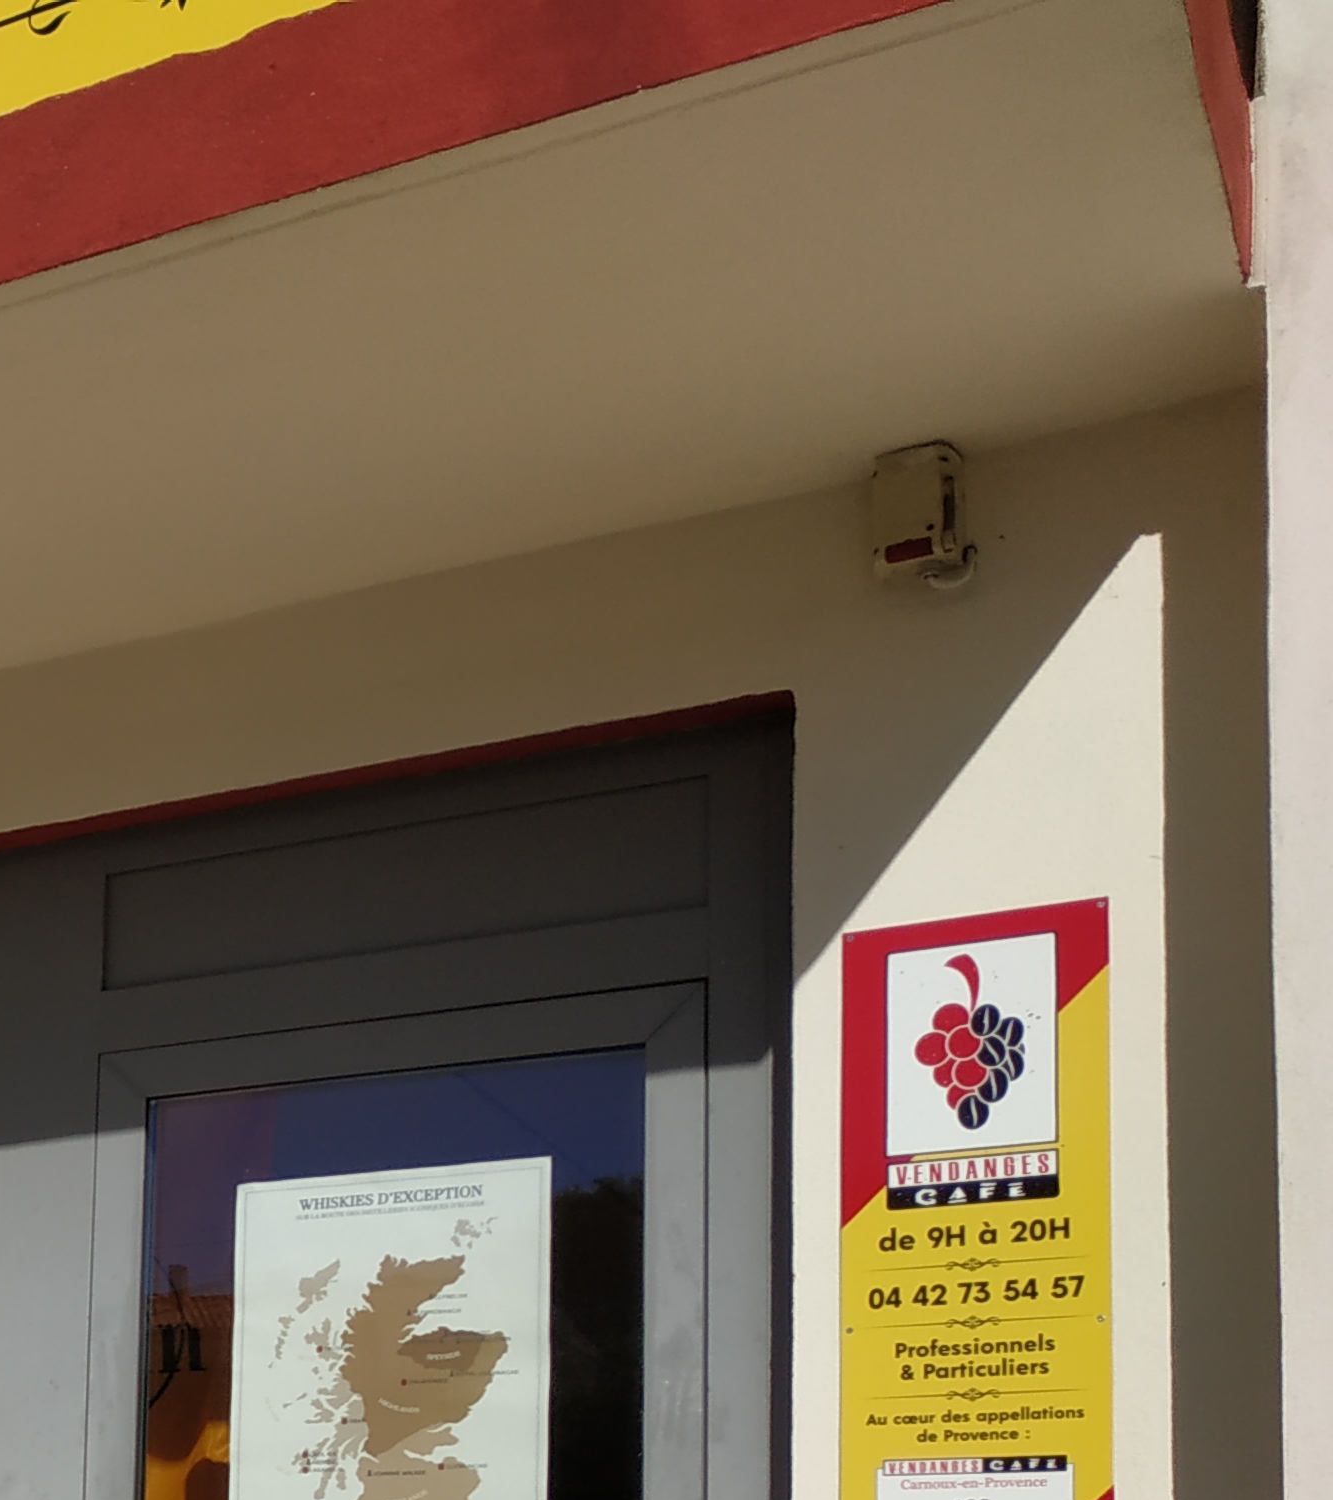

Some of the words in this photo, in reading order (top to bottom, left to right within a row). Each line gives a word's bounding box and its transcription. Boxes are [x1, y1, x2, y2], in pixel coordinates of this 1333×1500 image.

[896, 1153, 1050, 1185] VENDANGES
[299, 1194, 374, 1211] WHISKIES
[377, 1185, 483, 1205] D'EXCEPTION
[879, 1227, 915, 1252] de
[927, 1225, 966, 1249] 9H
[978, 1221, 997, 1245] à
[1010, 1217, 1071, 1243] 20H
[868, 1287, 902, 1310] 04
[912, 1284, 948, 1307] 42
[957, 1281, 990, 1304] 73
[1003, 1278, 1039, 1301] 54
[1051, 1275, 1085, 1299] 57
[894, 1333, 1056, 1359] Professionnels
[900, 1364, 914, 1381] &
[923, 1358, 1050, 1380] Particuliers
[866, 1413, 888, 1427] Au
[940, 1409, 971, 1424] des
[976, 1406, 1085, 1425] appellations
[916, 1430, 938, 1444] de
[943, 1428, 1020, 1443] Provence
[888, 1460, 979, 1475] VENDANGES
[900, 1476, 1048, 1490] Carnoux-en-Provence
